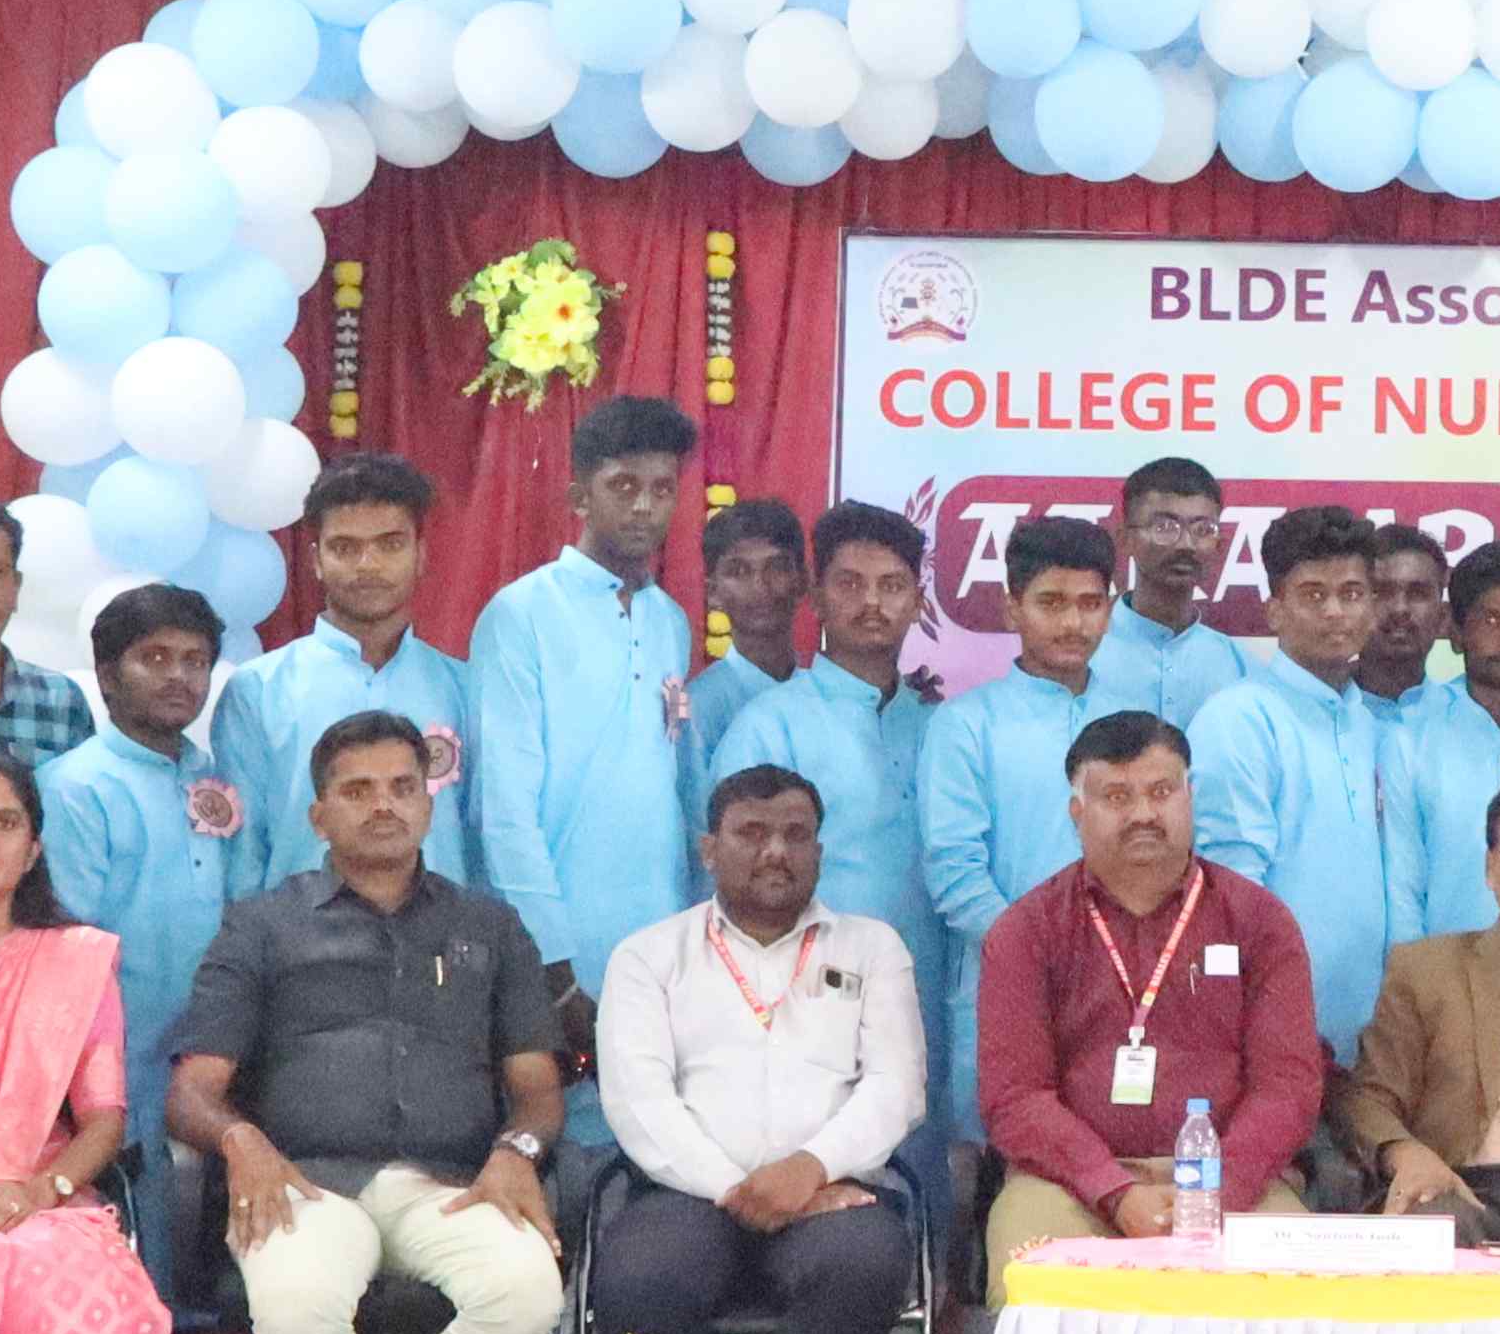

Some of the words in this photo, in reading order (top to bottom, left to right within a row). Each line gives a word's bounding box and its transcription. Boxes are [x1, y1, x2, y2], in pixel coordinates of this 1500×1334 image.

[1150, 265, 1327, 323] BLDE
[879, 368, 1217, 433] COLLEGE
[1245, 373, 1344, 435] OF
